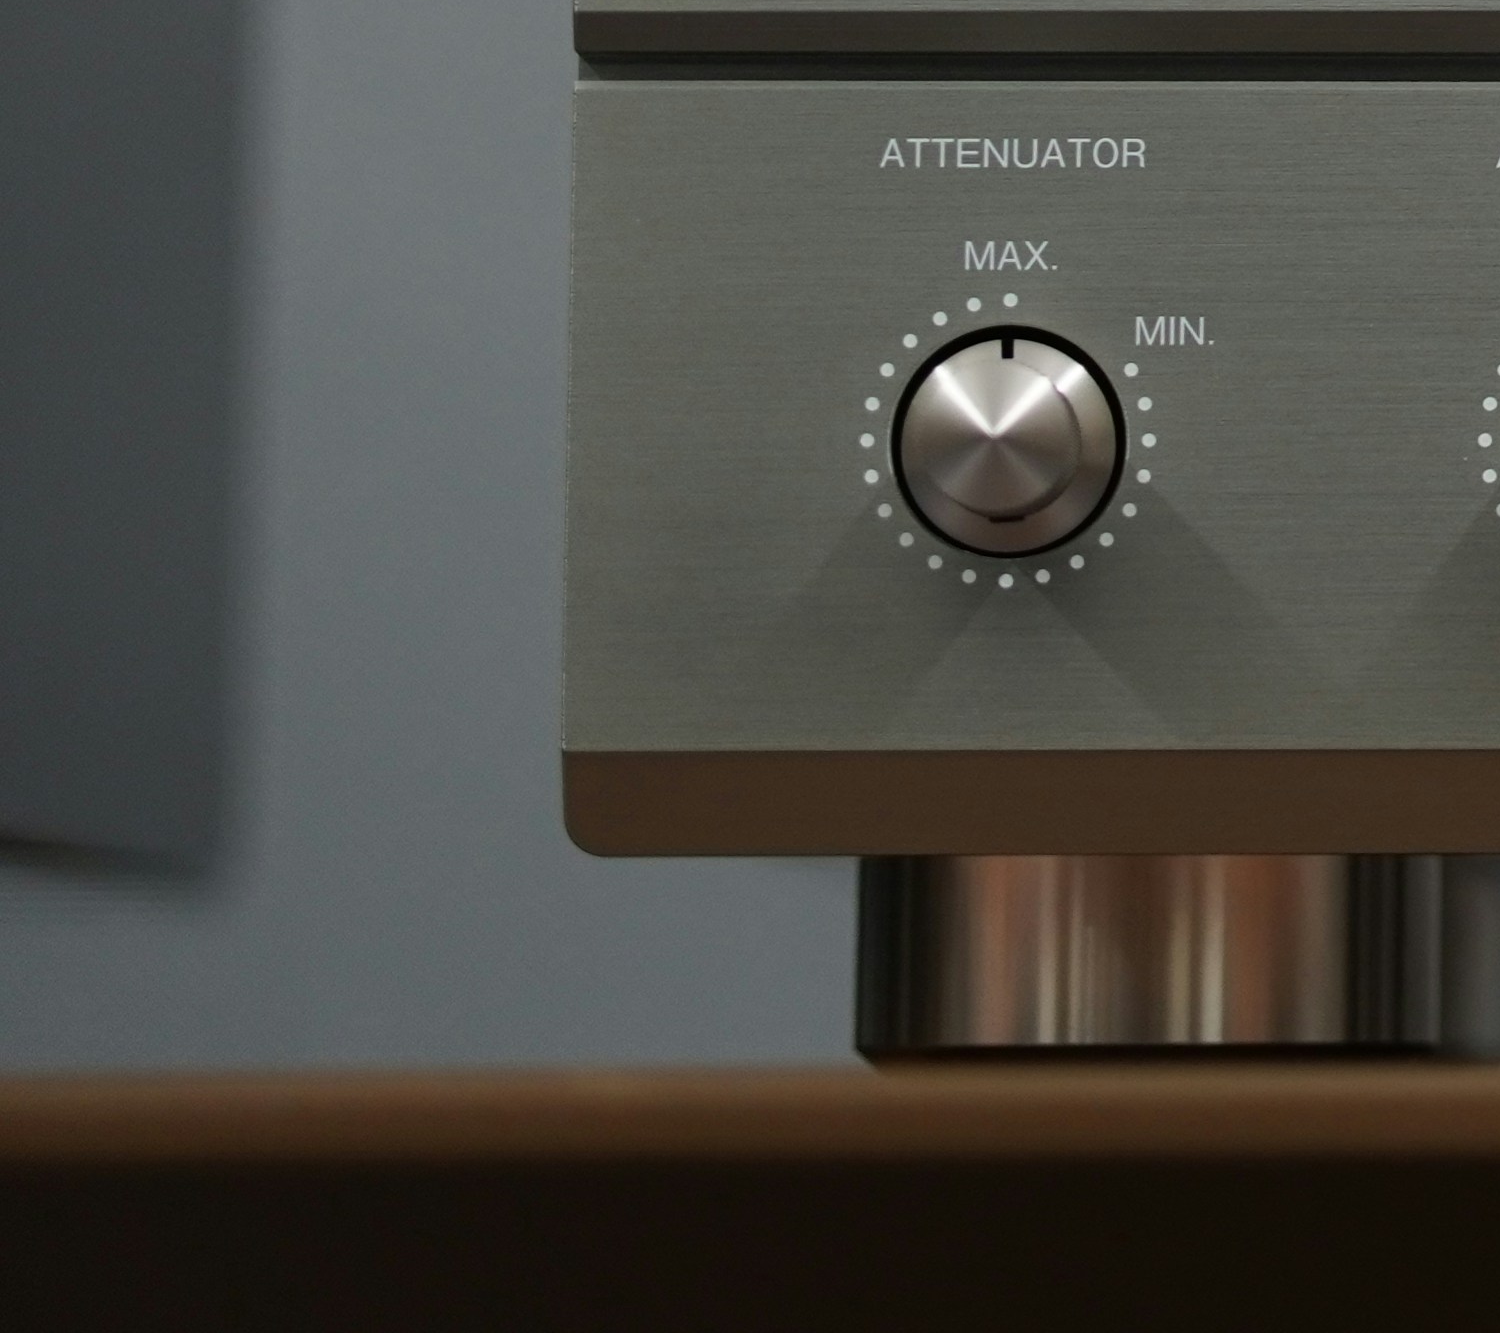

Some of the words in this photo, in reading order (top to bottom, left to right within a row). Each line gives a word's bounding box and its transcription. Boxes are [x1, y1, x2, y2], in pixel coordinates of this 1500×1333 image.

[880, 138, 1147, 170] ATTENUATOR
[965, 241, 1059, 272] MAX.
[1135, 316, 1216, 347] MIN.
